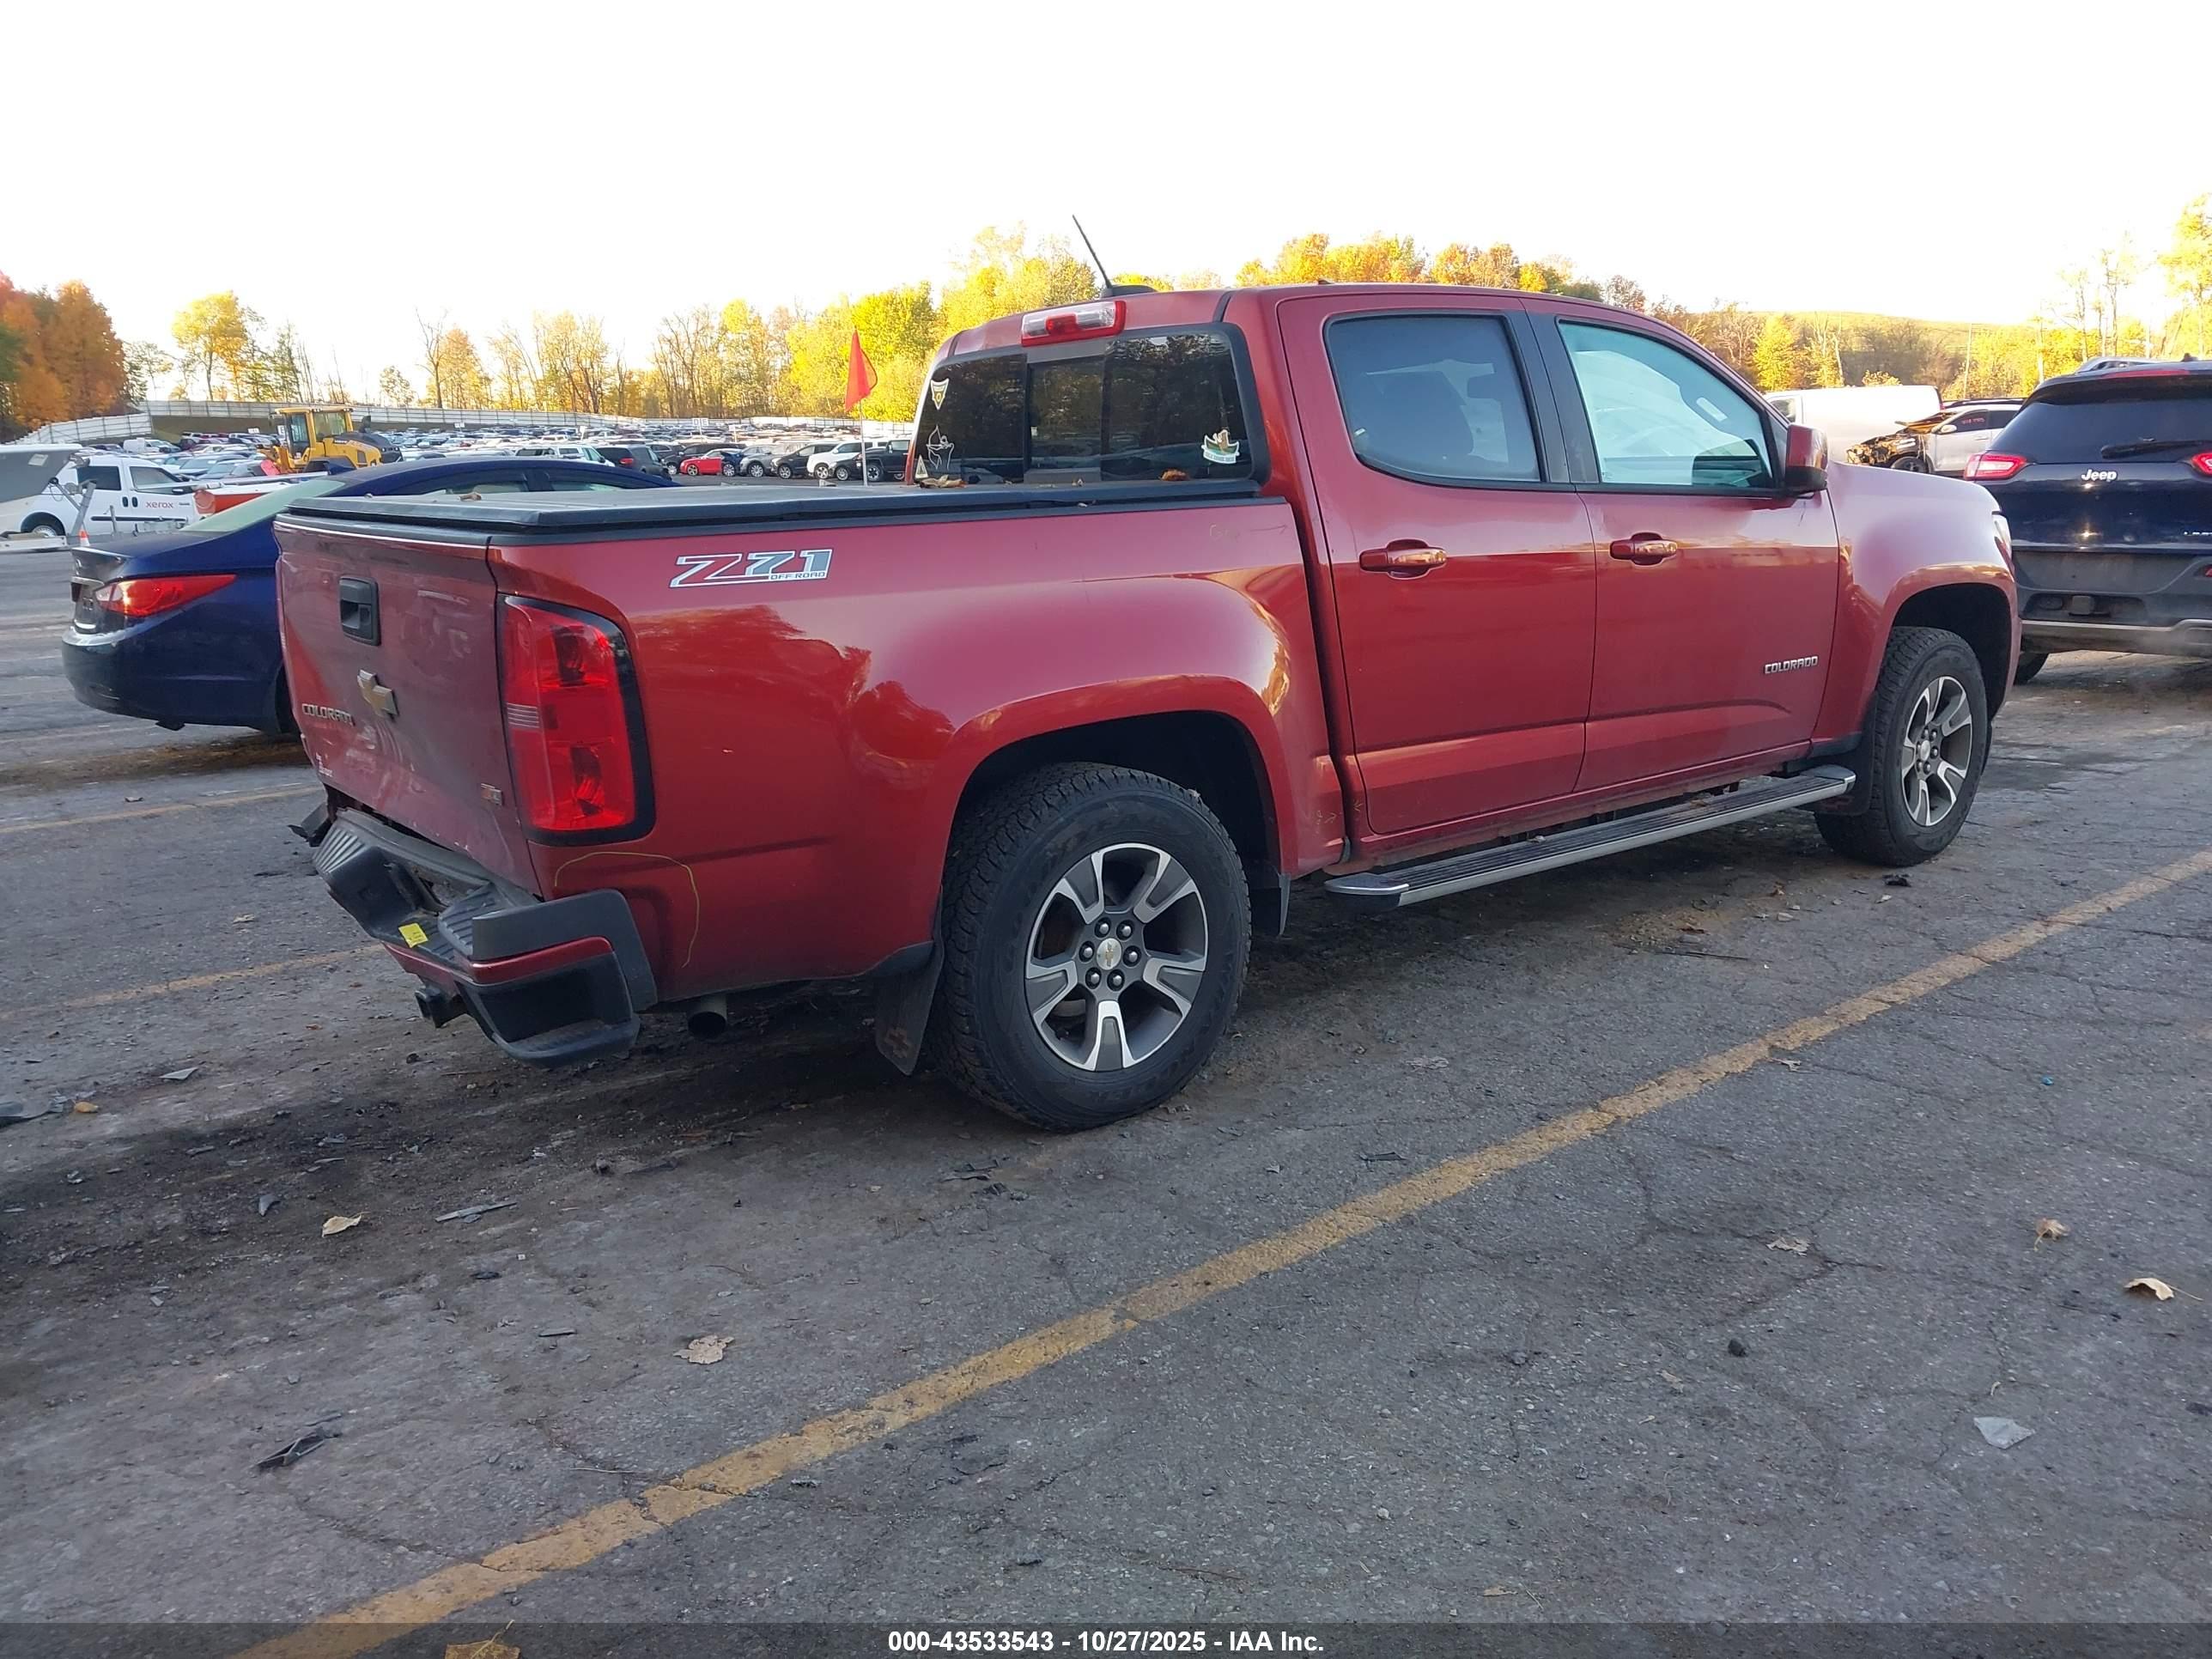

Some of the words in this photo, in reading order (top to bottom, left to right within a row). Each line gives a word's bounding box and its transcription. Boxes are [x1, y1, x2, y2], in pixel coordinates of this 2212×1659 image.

[2081, 469, 2118, 482] Jeep
[669, 549, 833, 587] Z71
[794, 571, 825, 580] ROAD
[1765, 656, 1818, 674] COLORADO
